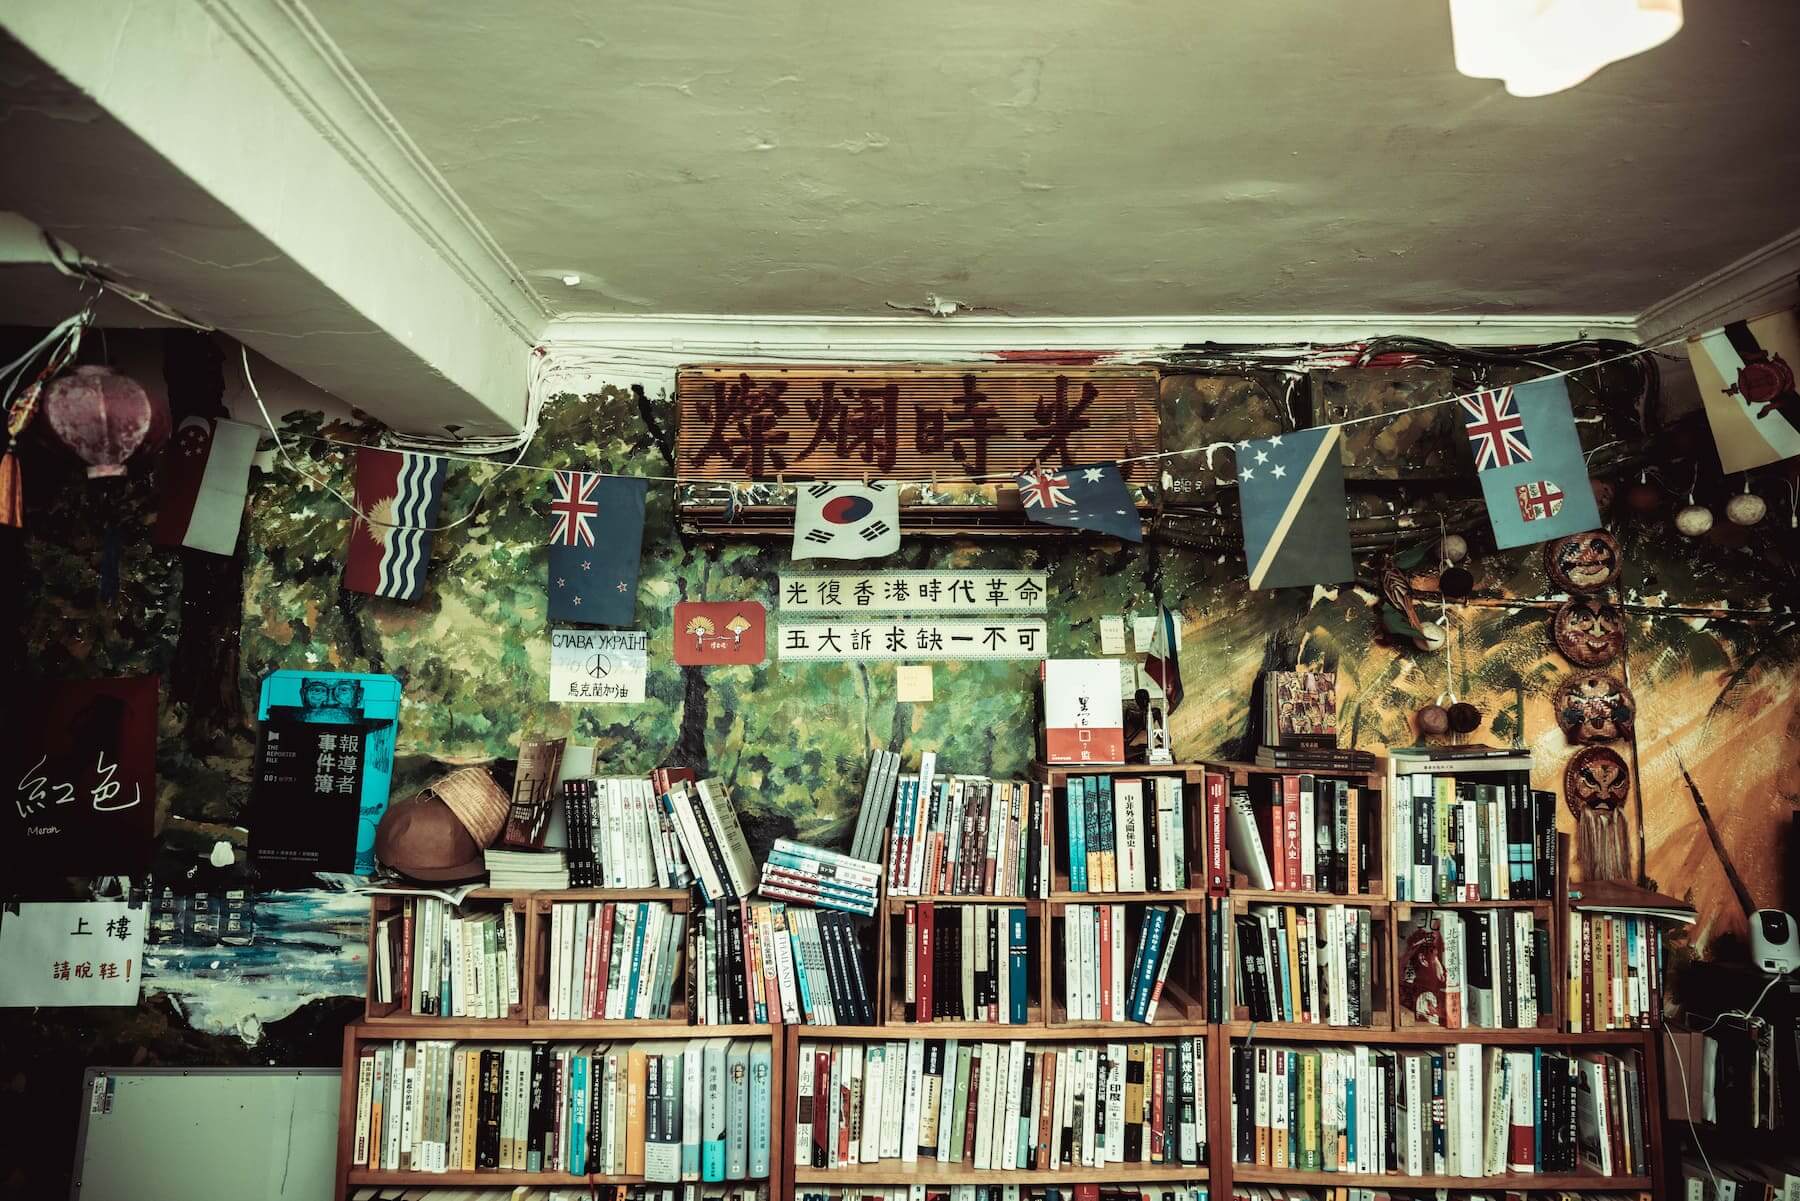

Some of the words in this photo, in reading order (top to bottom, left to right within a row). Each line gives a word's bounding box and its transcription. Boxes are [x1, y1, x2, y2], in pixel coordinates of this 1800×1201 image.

[785, 577, 1044, 607] 光復香港時代革命
[552, 634, 594, 649] СЛАВА
[785, 626, 1042, 653] 五大訴求缺一不可
[568, 682, 629, 698] 烏克蘭加油
[314, 734, 337, 793] 事件簿
[335, 735, 359, 794] 報導者
[16, 750, 141, 819] 紅色
[70, 917, 132, 941] 上樓
